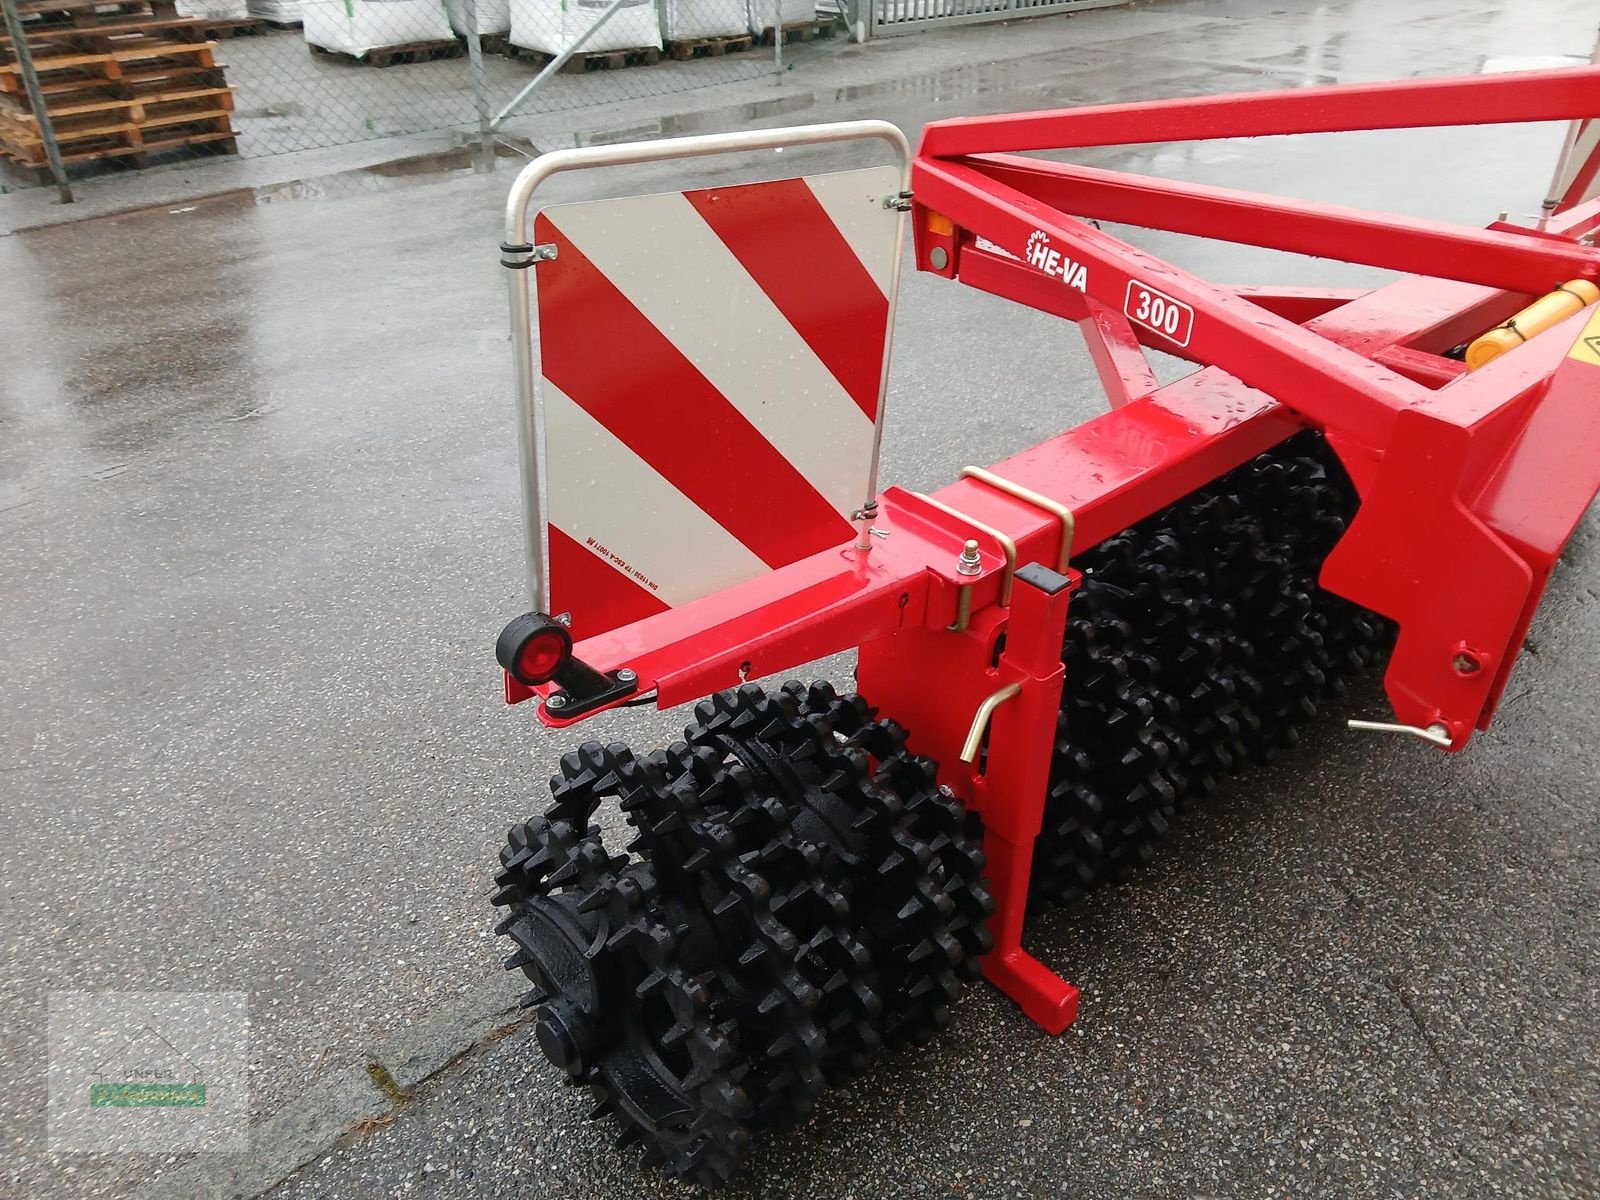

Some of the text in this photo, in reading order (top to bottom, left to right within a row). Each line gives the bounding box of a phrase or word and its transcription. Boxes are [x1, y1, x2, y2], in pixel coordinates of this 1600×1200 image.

[1031, 242, 1088, 293] HE-VA
[1136, 291, 1179, 335] 300
[648, 581, 659, 590] DIN
